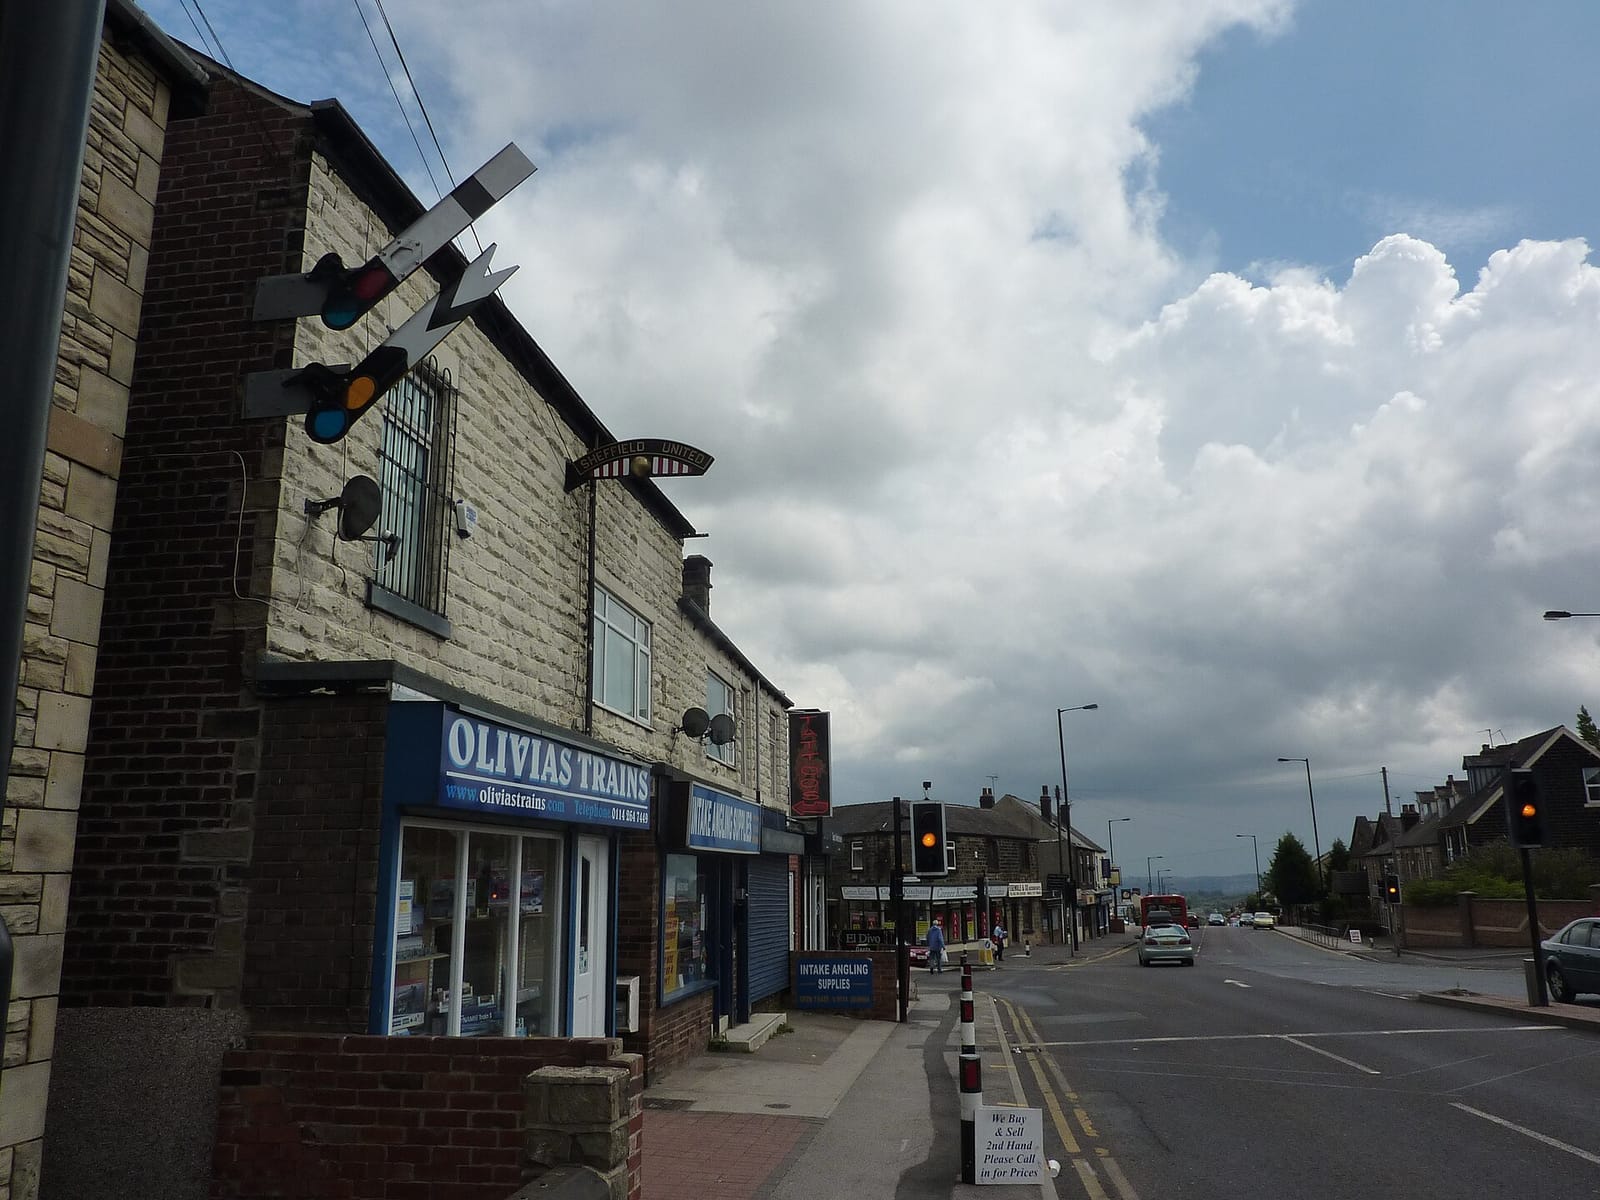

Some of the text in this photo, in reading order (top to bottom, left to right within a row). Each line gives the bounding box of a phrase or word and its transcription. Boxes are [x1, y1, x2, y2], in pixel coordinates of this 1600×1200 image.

[580, 441, 705, 470] SHEFFIELD UNITED
[448, 718, 648, 801] OLIVIAS TRAINS
[799, 715, 820, 801] TATTOOS
[446, 783, 565, 813] www.oliviastrains.com
[611, 807, 625, 821] 0114
[691, 796, 713, 838] INTAKE
[733, 807, 752, 842] SUPPLIES
[846, 932, 880, 944] El Divo
[800, 964, 868, 975] INTAKE ANGLING
[818, 979, 850, 989] SUPPLIES
[992, 1113, 1027, 1126] We Buy
[994, 1127, 1024, 1137] & Sell
[986, 1140, 1033, 1150] 2nd Hand
[983, 1153, 1036, 1164] Please Call
[980, 1167, 1039, 1180] in for Prices
